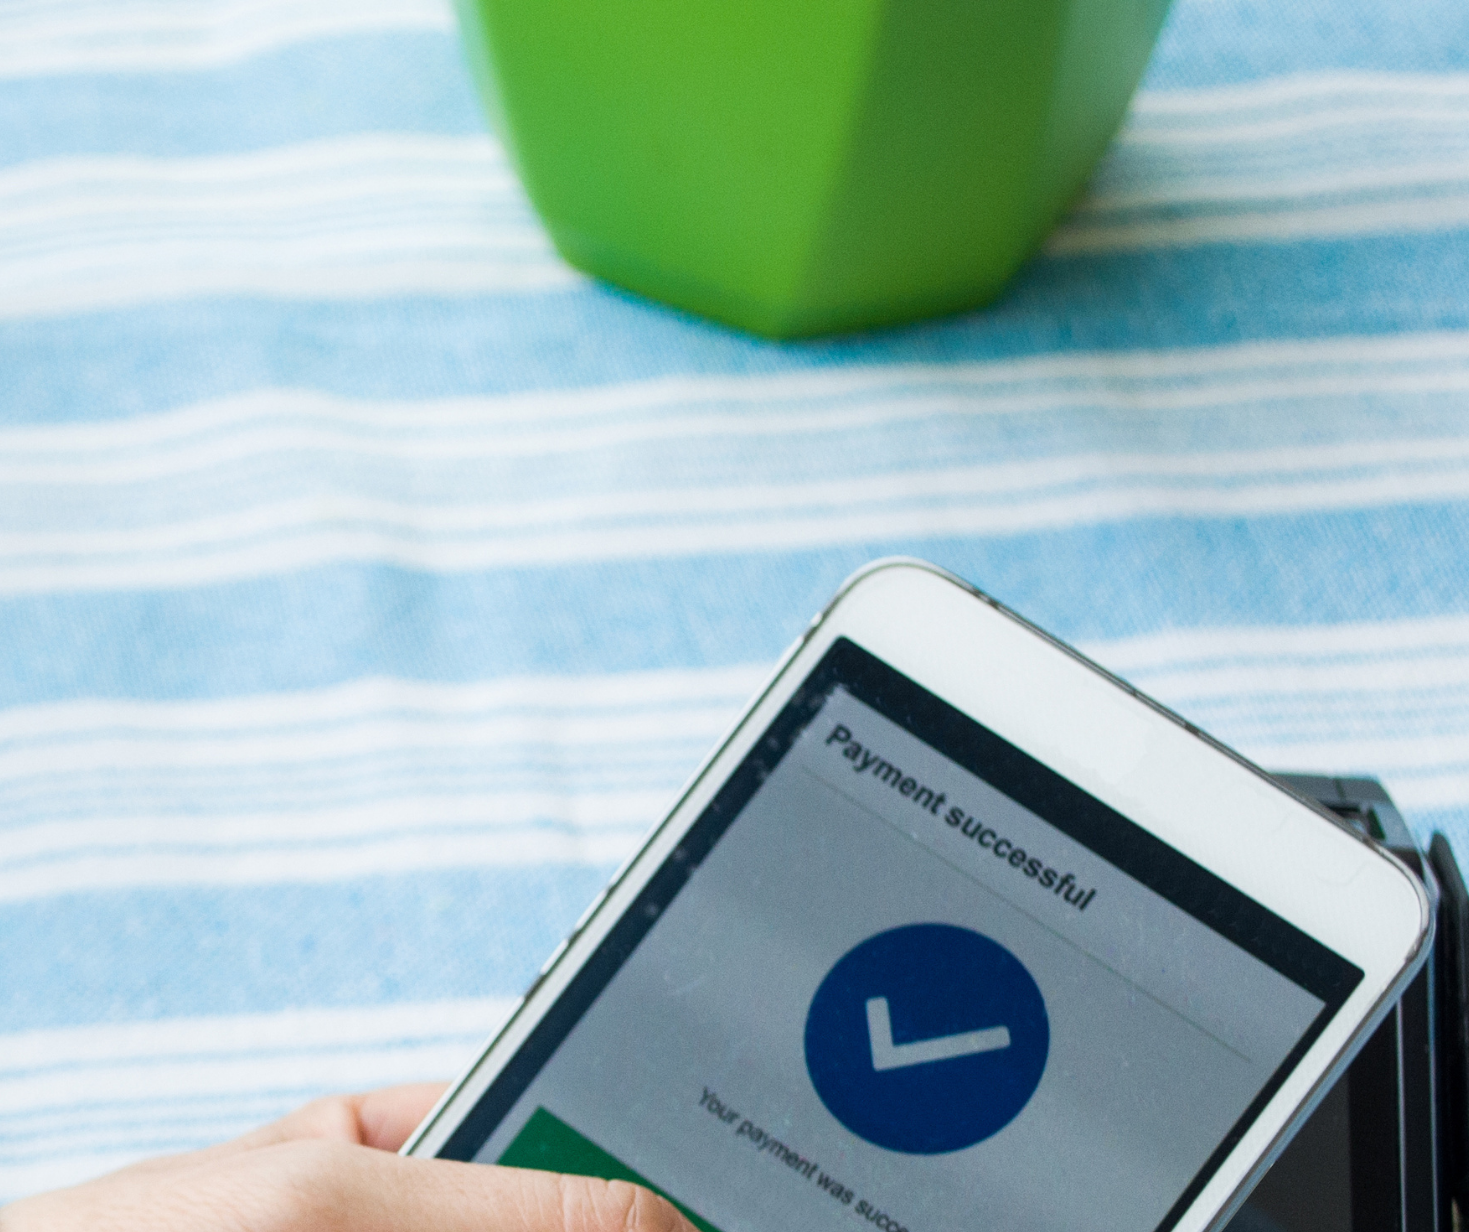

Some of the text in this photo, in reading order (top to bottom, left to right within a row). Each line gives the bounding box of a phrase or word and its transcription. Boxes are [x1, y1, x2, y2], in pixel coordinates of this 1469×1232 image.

[824, 722, 1098, 913] Payment successful
[699, 1085, 741, 1126] Your
[735, 1118, 820, 1181] payment
[816, 1171, 856, 1206] was
